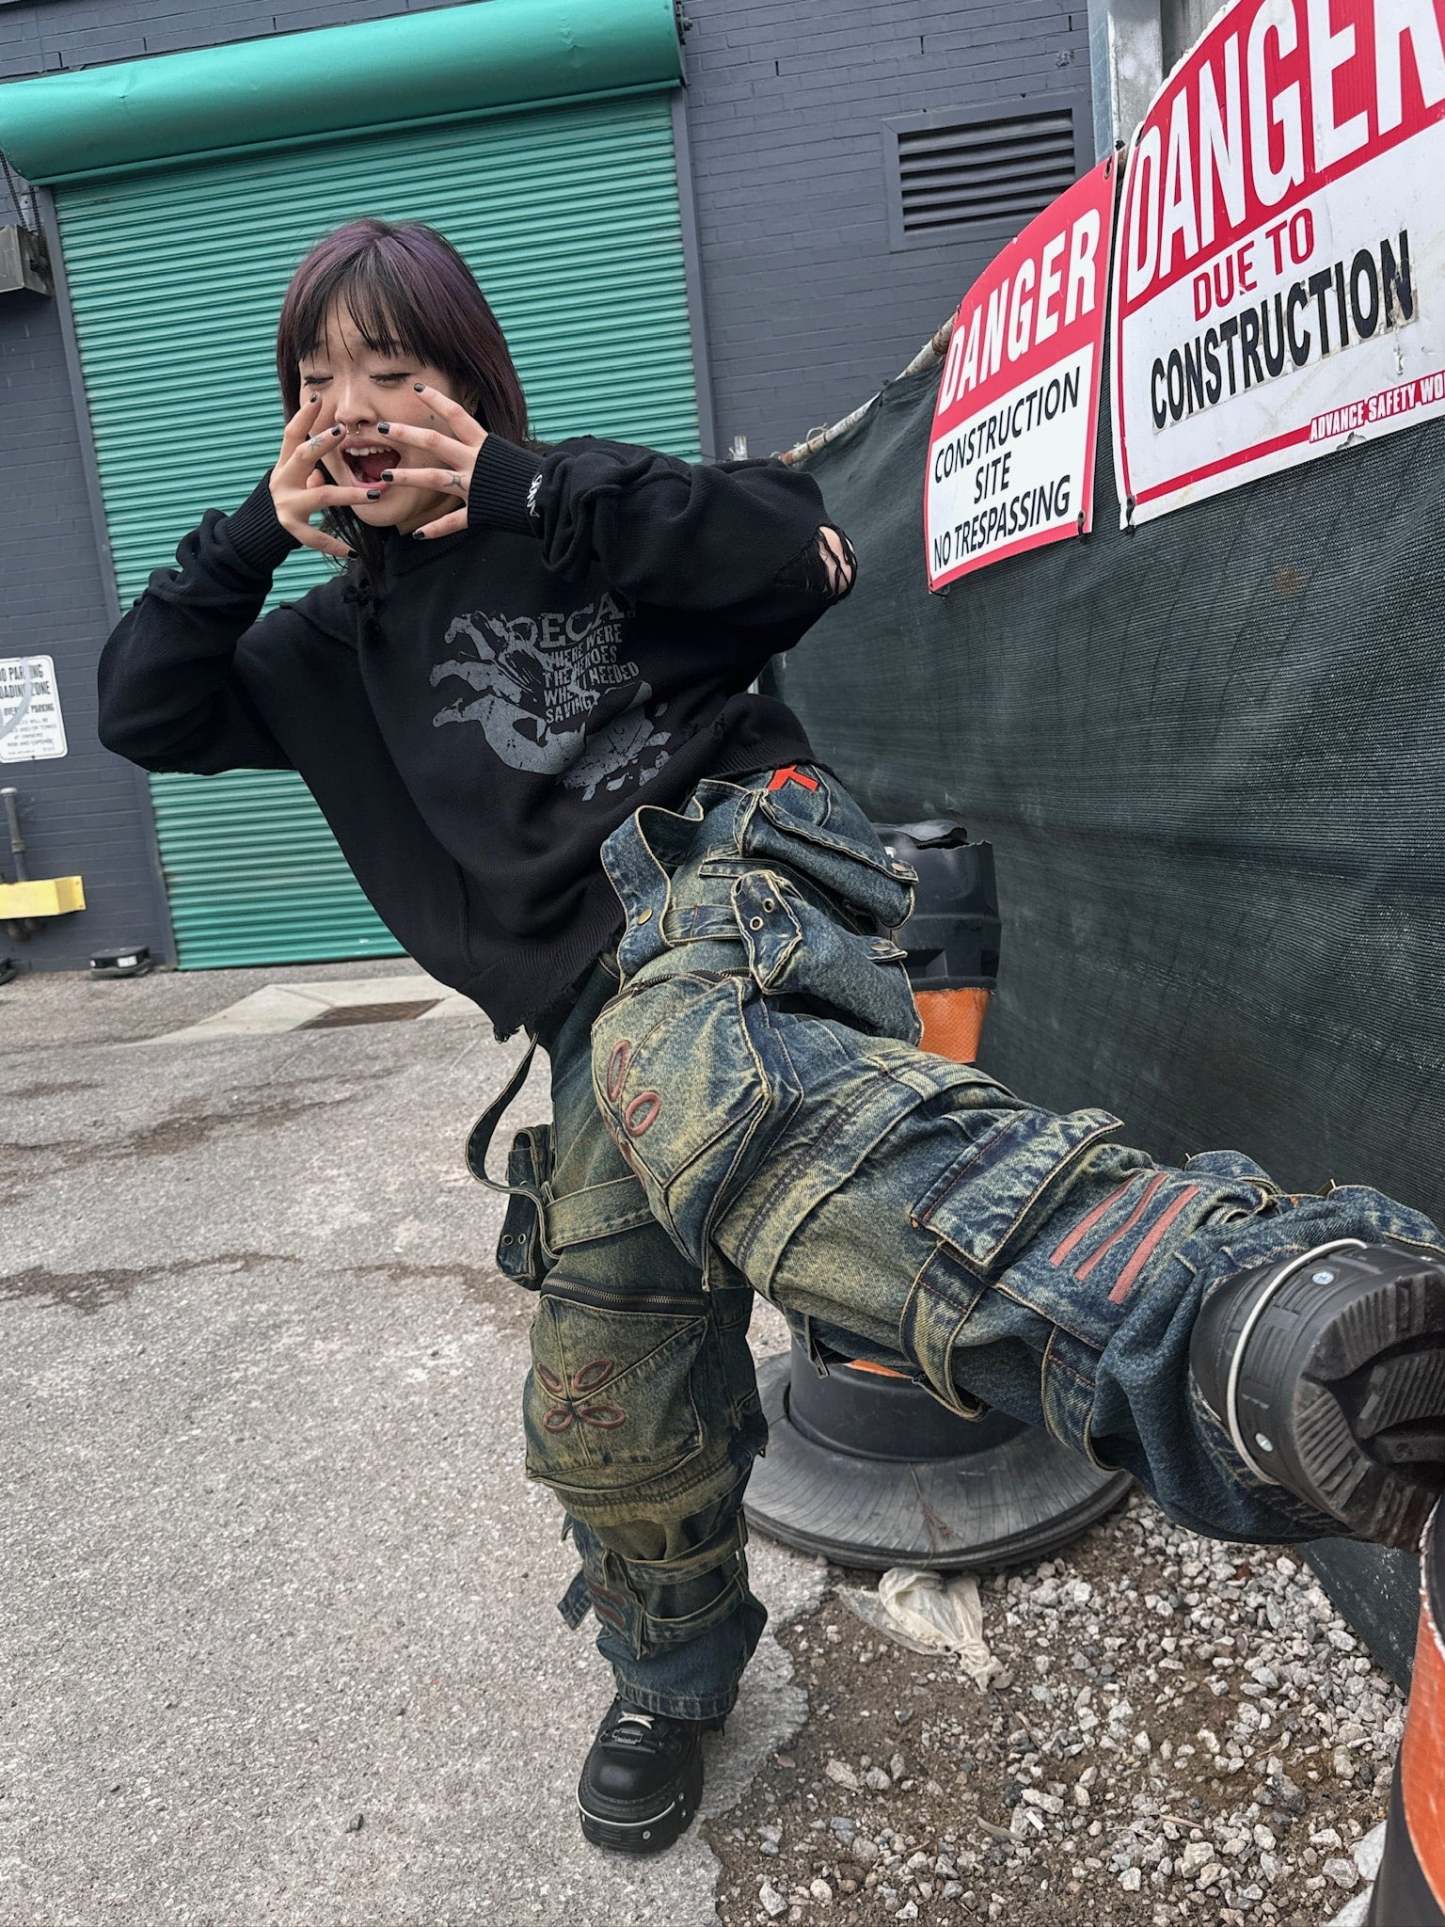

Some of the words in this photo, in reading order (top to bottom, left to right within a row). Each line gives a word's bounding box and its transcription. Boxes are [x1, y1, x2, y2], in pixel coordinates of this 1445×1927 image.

[1193, 240, 1257, 321] DUE
[1265, 208, 1315, 275] TO
[938, 208, 1100, 416] DANGER
[1151, 229, 1414, 429] CONSTRUCTION
[935, 366, 1080, 484] CONSTRUCTION
[1309, 400, 1365, 443] ADVANCE
[1367, 380, 1416, 422] SAFETY
[1420, 370, 1445, 405] WO
[974, 451, 1012, 504] SITE
[934, 530, 951, 572] NO
[955, 474, 1071, 560] TRESPASSING
[506, 592, 636, 651] DECA
[587, 624, 623, 651] WERE
[542, 667, 571, 688] THE
[574, 645, 617, 676] HEROES
[589, 662, 640, 686] NEEDED
